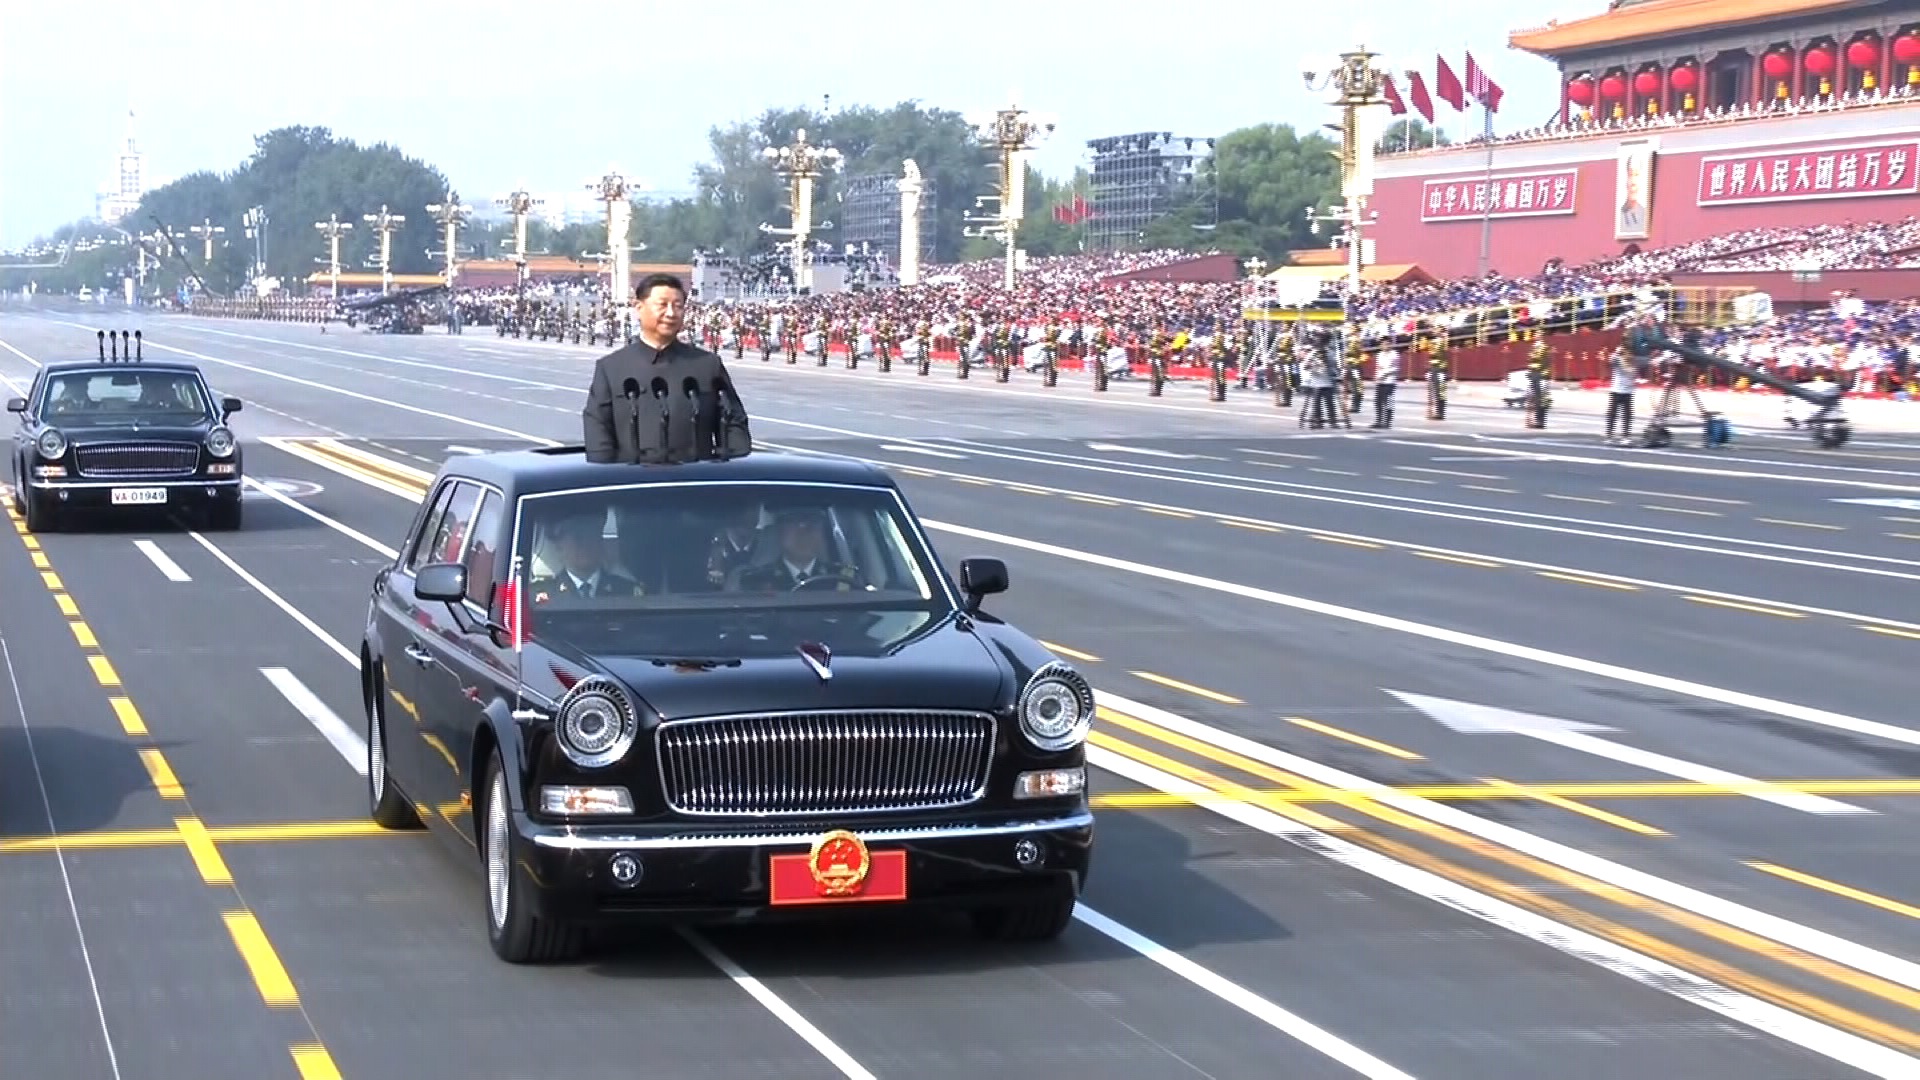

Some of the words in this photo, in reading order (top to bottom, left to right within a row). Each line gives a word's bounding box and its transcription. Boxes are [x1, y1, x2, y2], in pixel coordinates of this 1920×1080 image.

[1709, 149, 1908, 197] 世界人民大团结万岁
